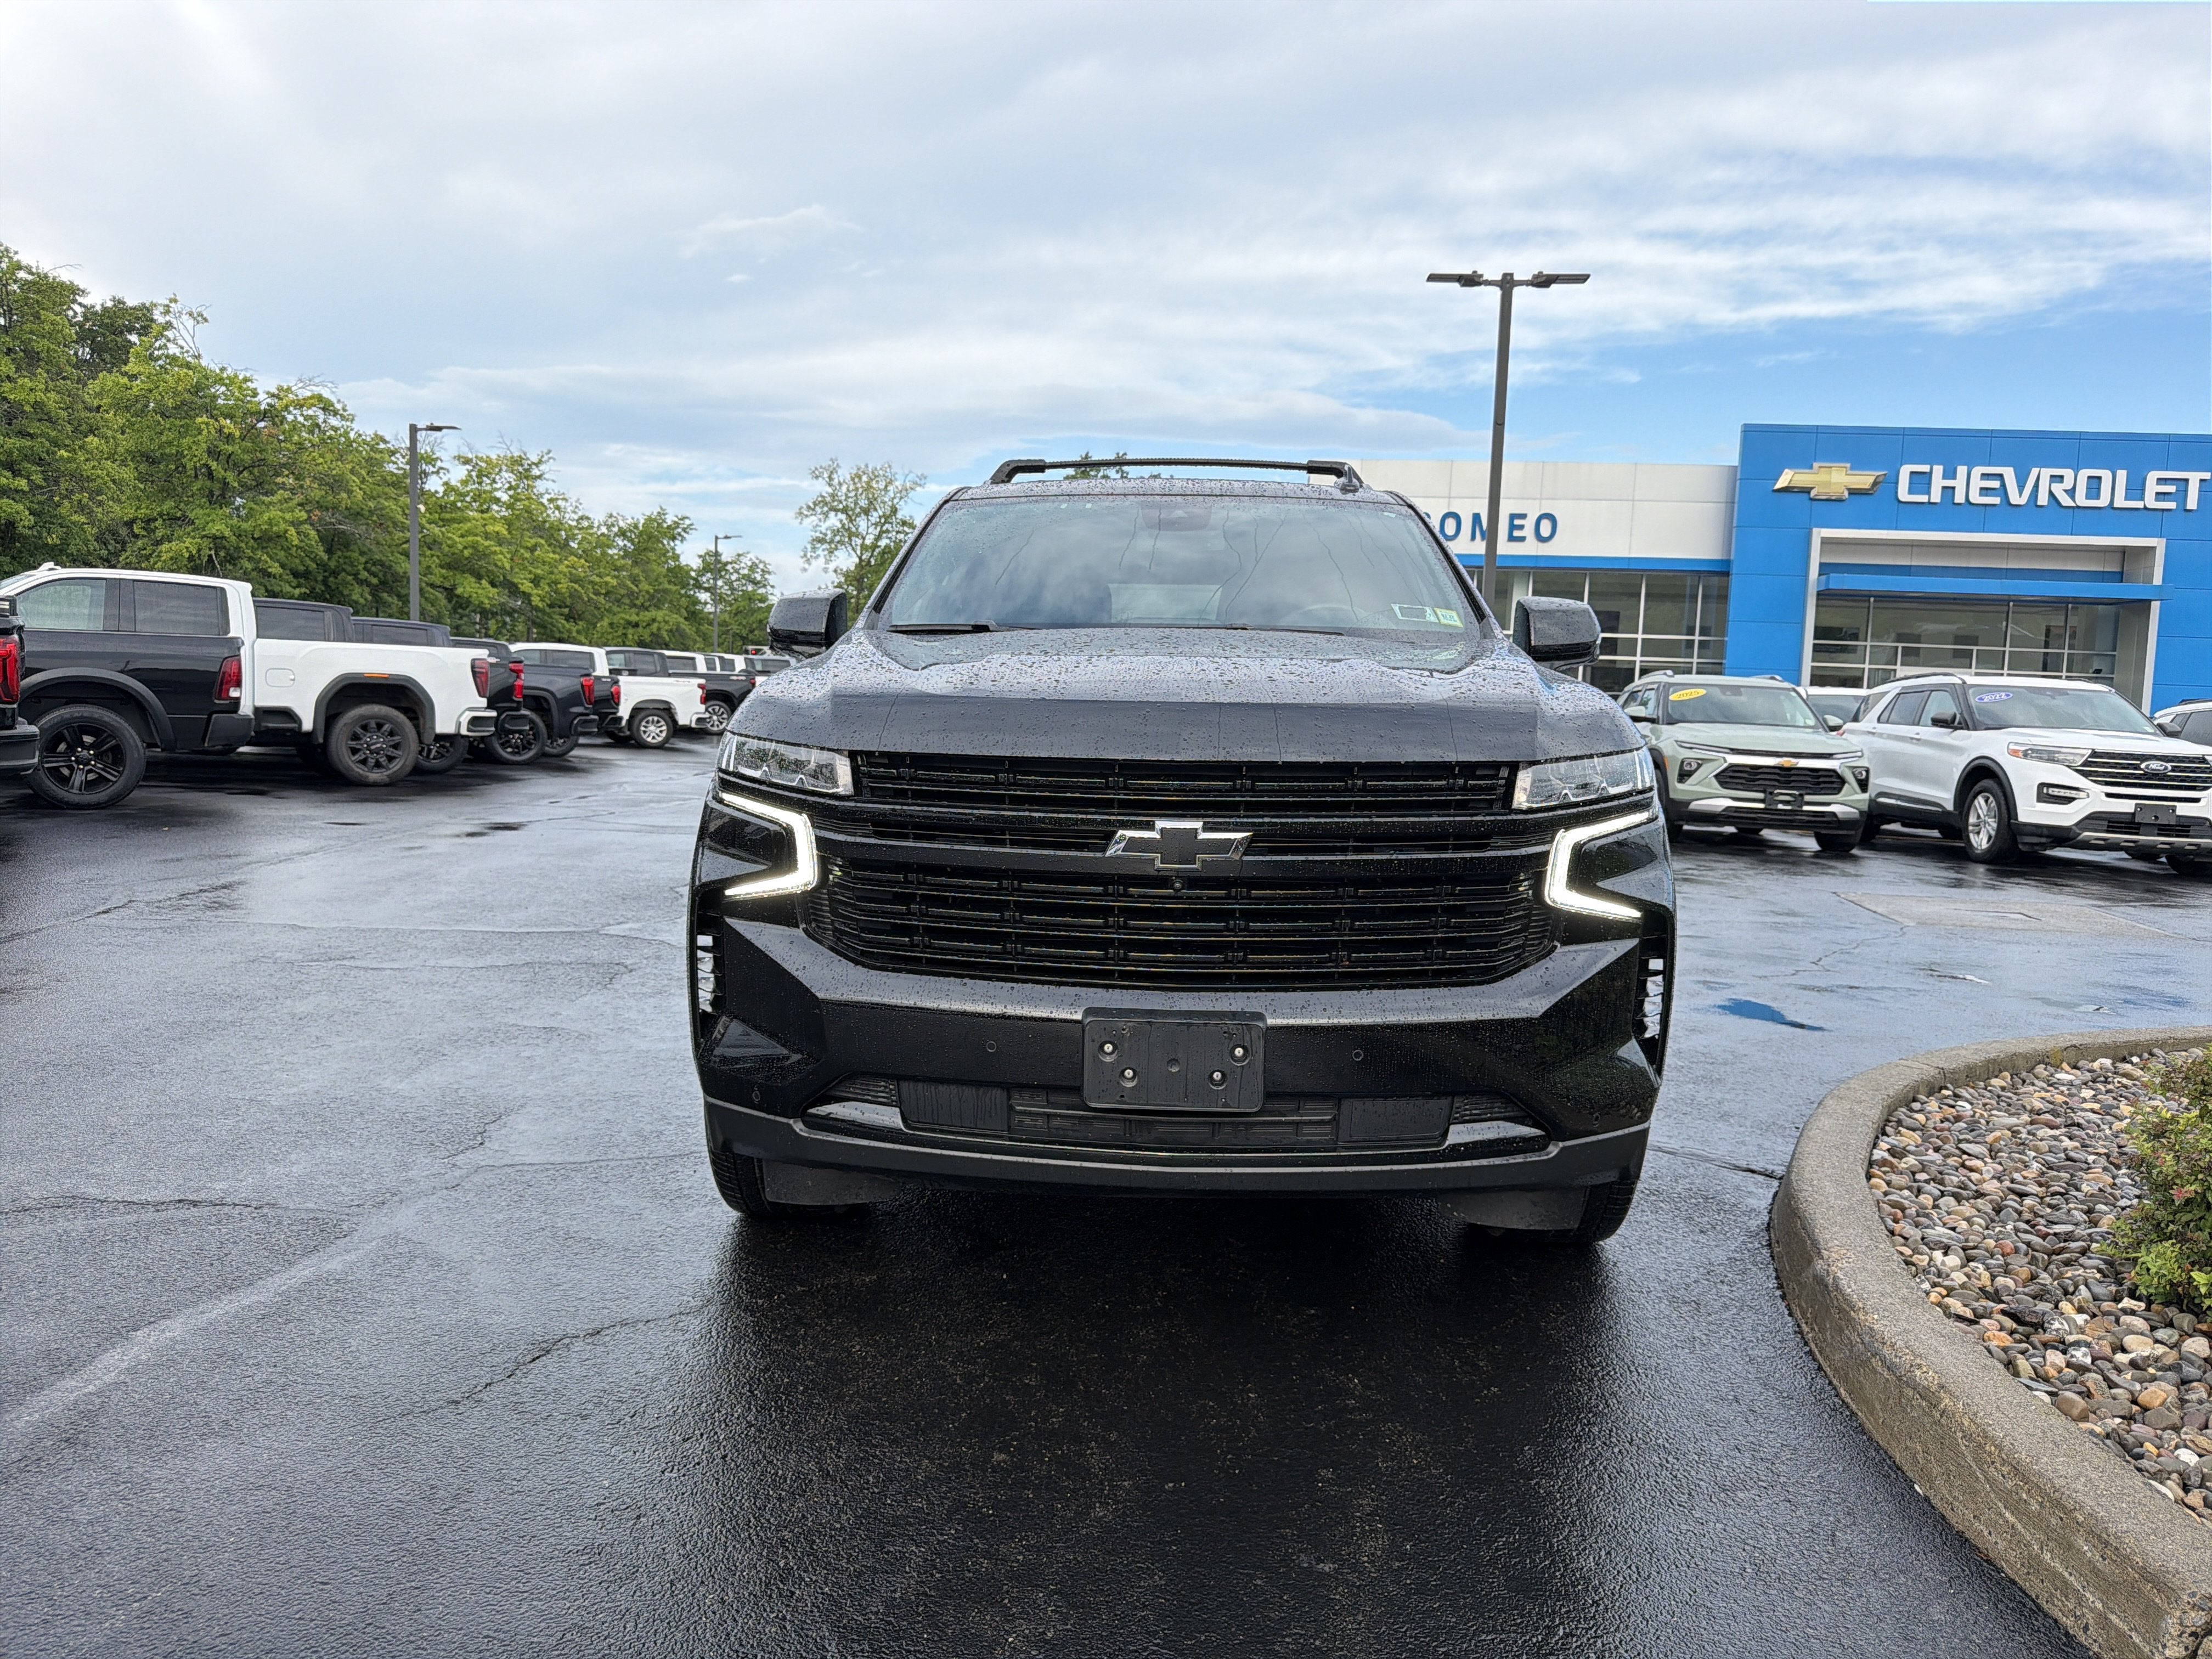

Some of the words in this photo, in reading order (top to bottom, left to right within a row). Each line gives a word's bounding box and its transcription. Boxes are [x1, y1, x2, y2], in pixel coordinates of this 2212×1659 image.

[1898, 464, 2211, 510] CHEVROLET
[1423, 511, 1558, 543] OMEO
[1676, 690, 1700, 699] 2025
[1982, 692, 2006, 702] 2022
